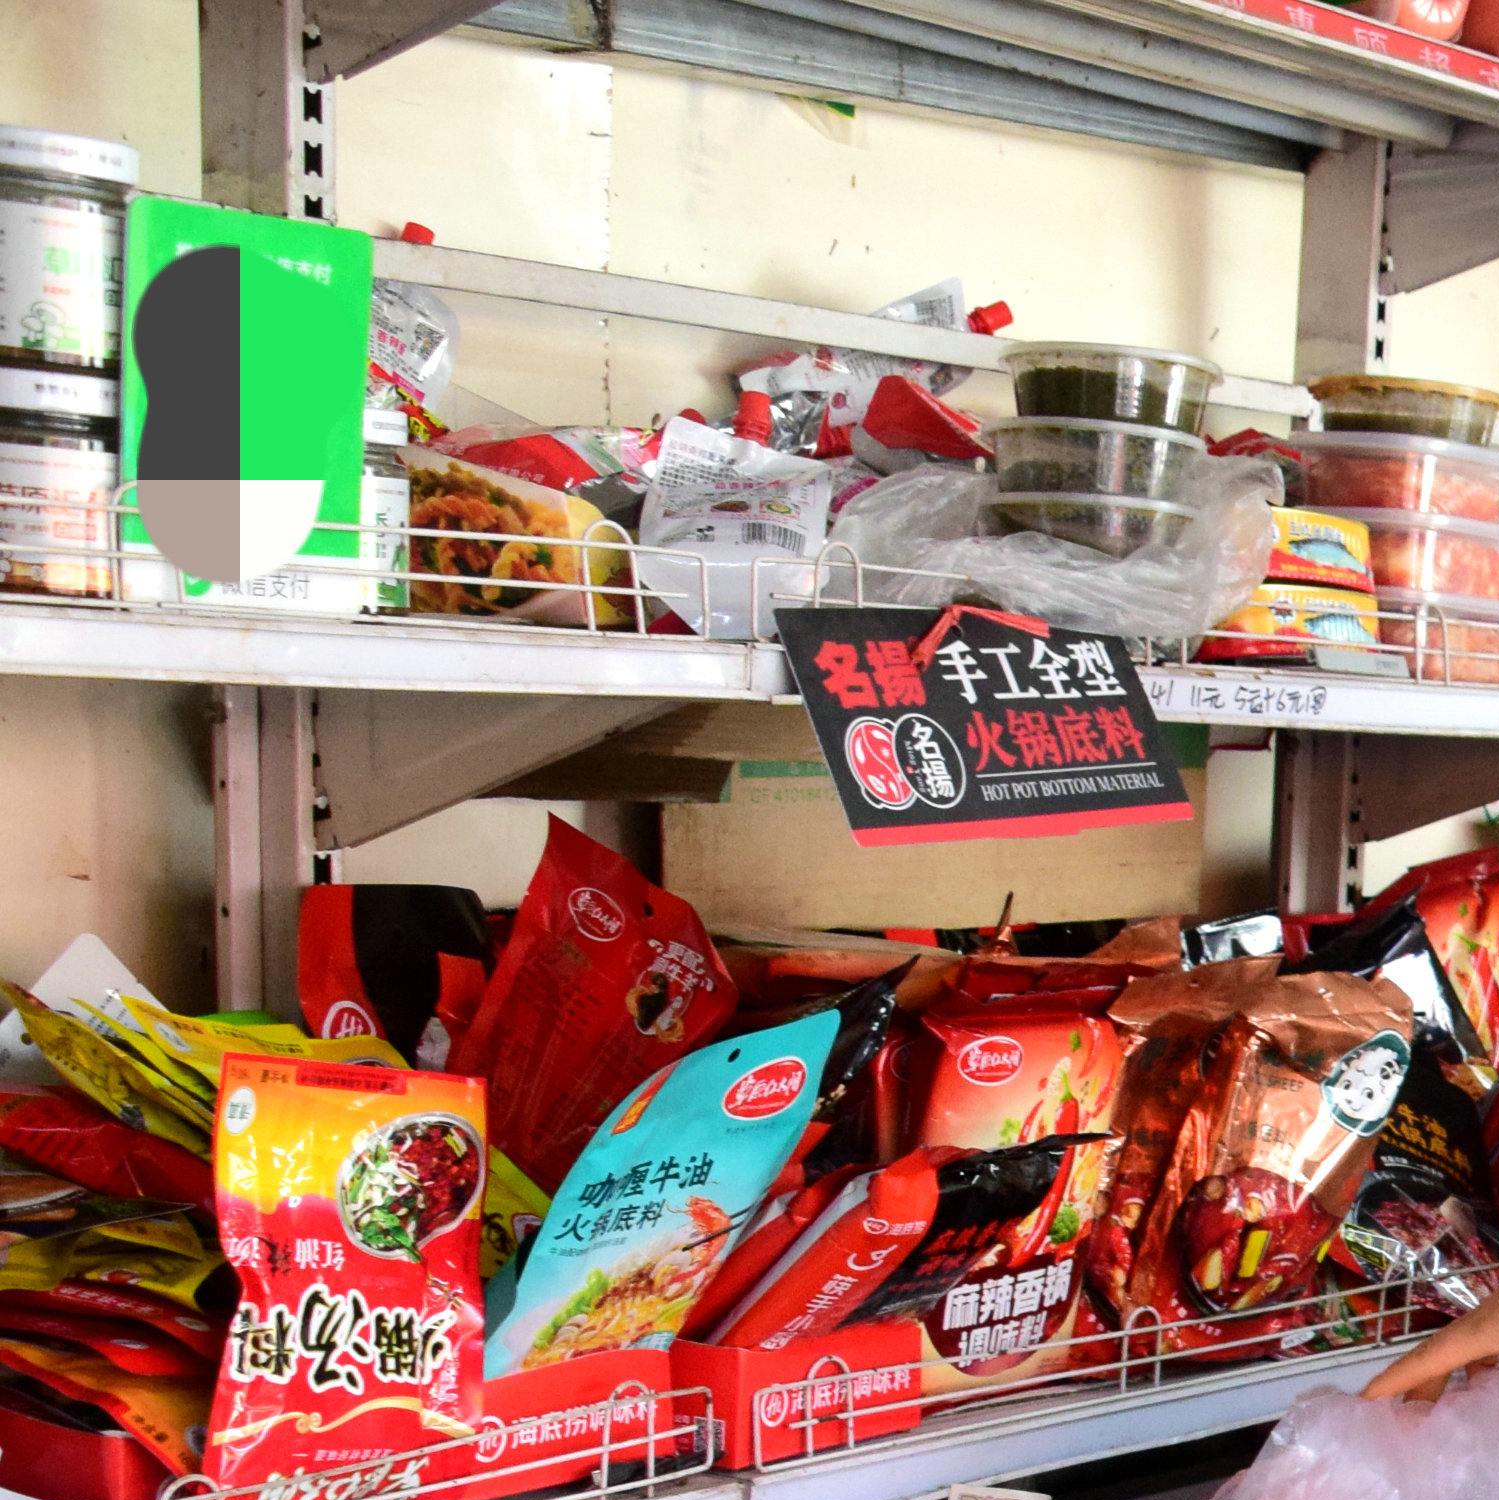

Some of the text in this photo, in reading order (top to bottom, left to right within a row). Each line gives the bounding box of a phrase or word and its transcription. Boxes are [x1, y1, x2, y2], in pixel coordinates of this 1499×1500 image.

[966, 705, 1147, 773] 火锅底料
[981, 772, 1164, 802] HOT POT BOTTOM MATERIAL
[579, 1152, 716, 1207] 咖喱牛油
[553, 1197, 668, 1243] 火锅底料
[943, 1256, 1073, 1332] 麻辣香锅
[958, 1310, 1047, 1370] 调味料
